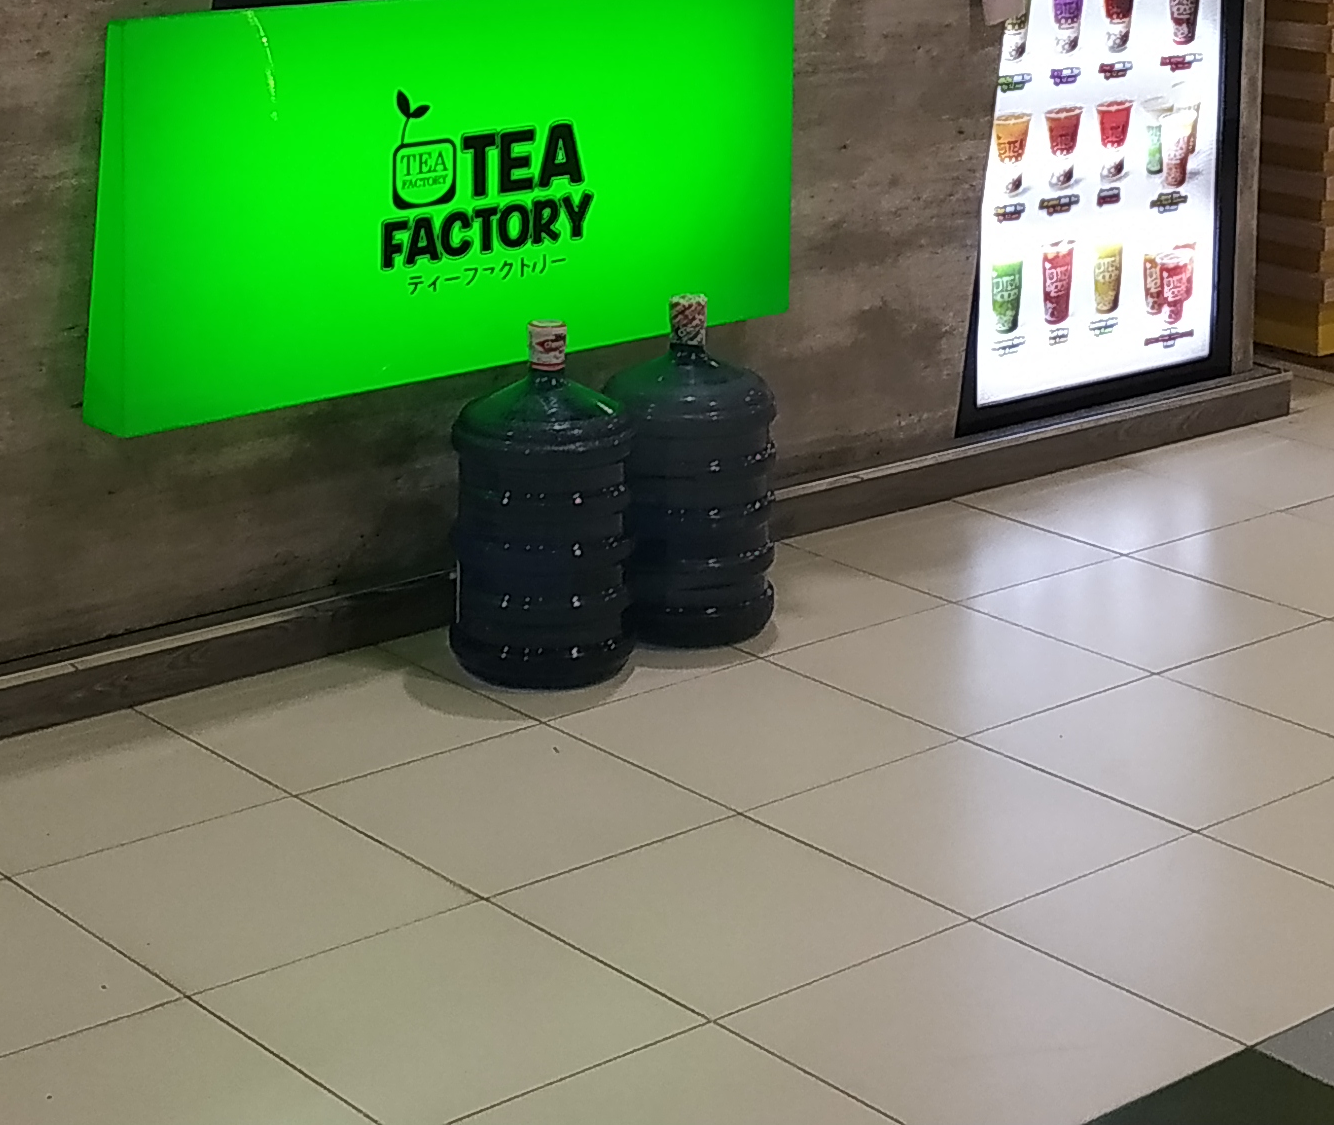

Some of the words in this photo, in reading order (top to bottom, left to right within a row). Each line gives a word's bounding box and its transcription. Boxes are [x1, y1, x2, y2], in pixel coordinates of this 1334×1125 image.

[400, 150, 449, 176] TEA
[401, 174, 449, 191] FACTORY
[462, 120, 585, 200] TEA
[380, 189, 595, 272] FACTORY
